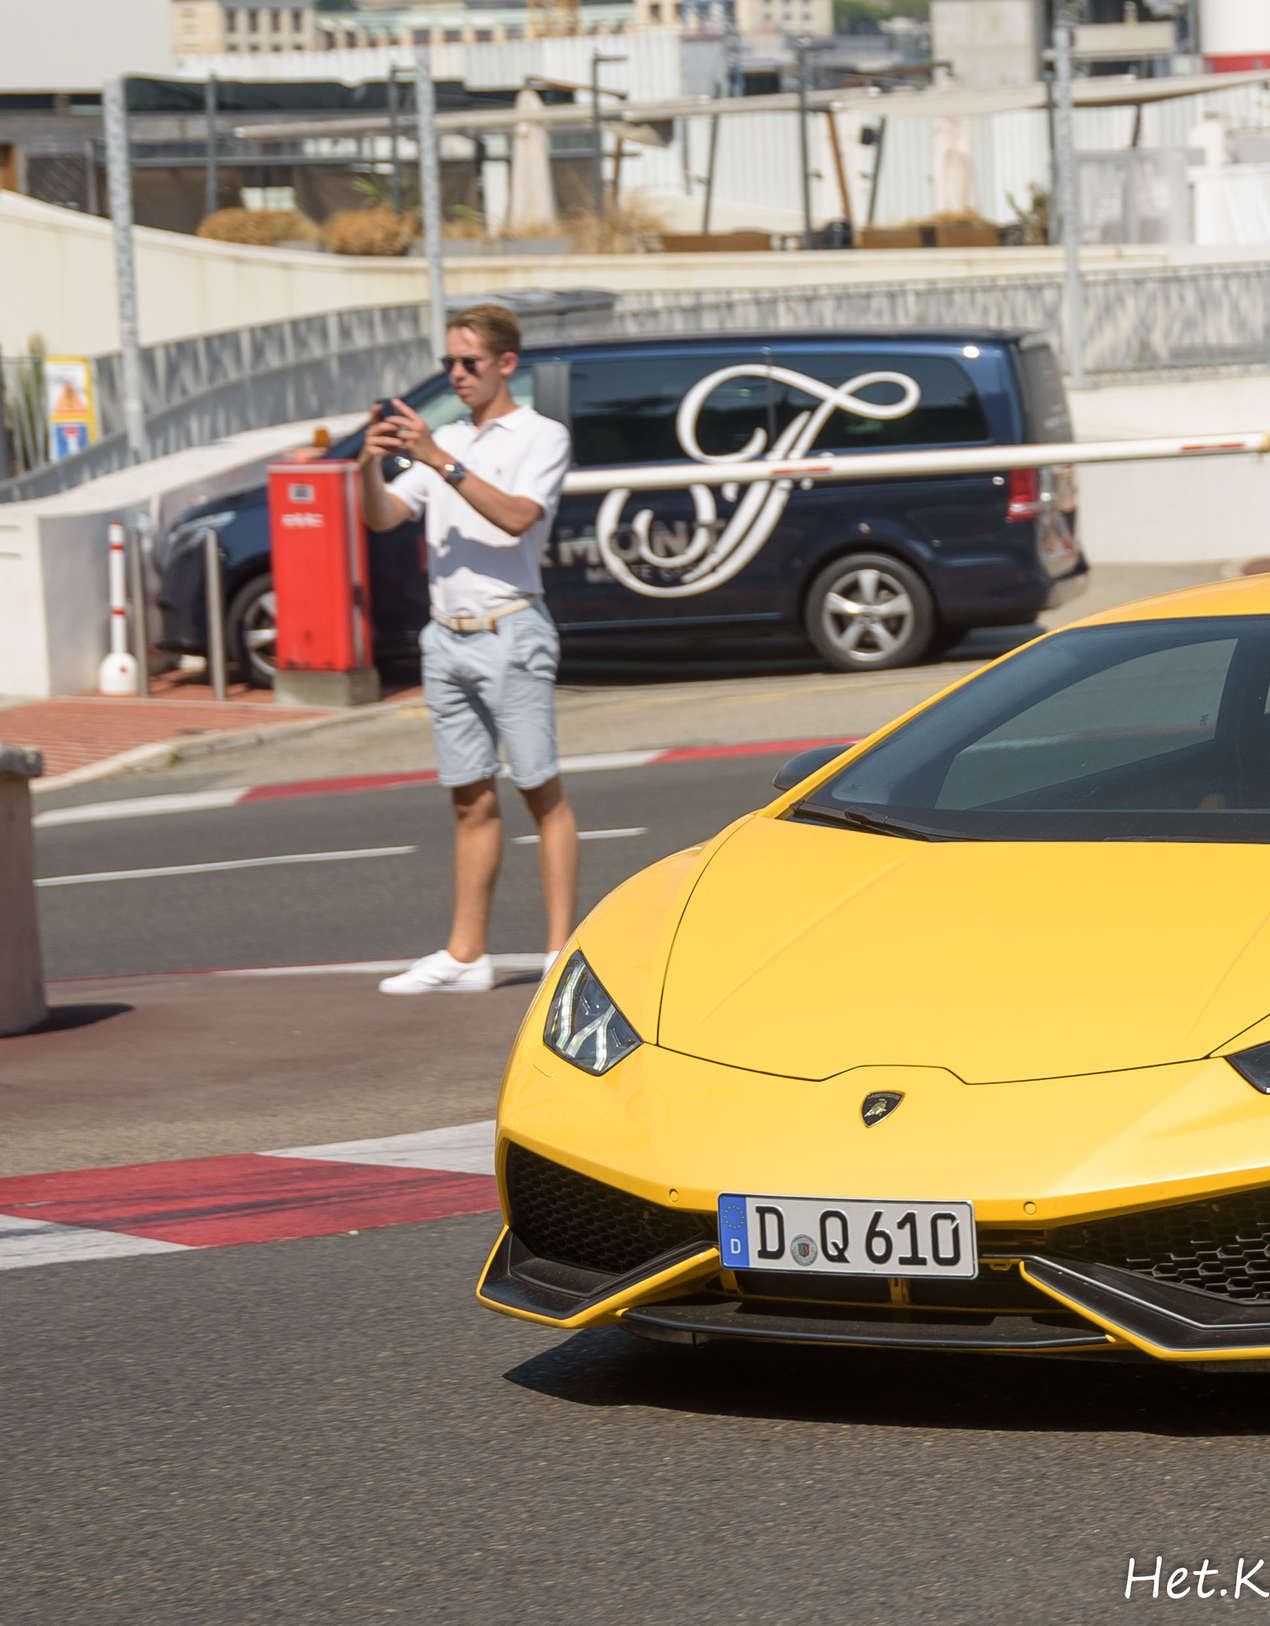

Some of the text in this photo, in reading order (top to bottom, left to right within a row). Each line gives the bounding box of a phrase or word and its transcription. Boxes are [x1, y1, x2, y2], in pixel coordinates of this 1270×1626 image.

[730, 1238, 742, 1254] D
[756, 1206, 961, 1266] D Q 610
